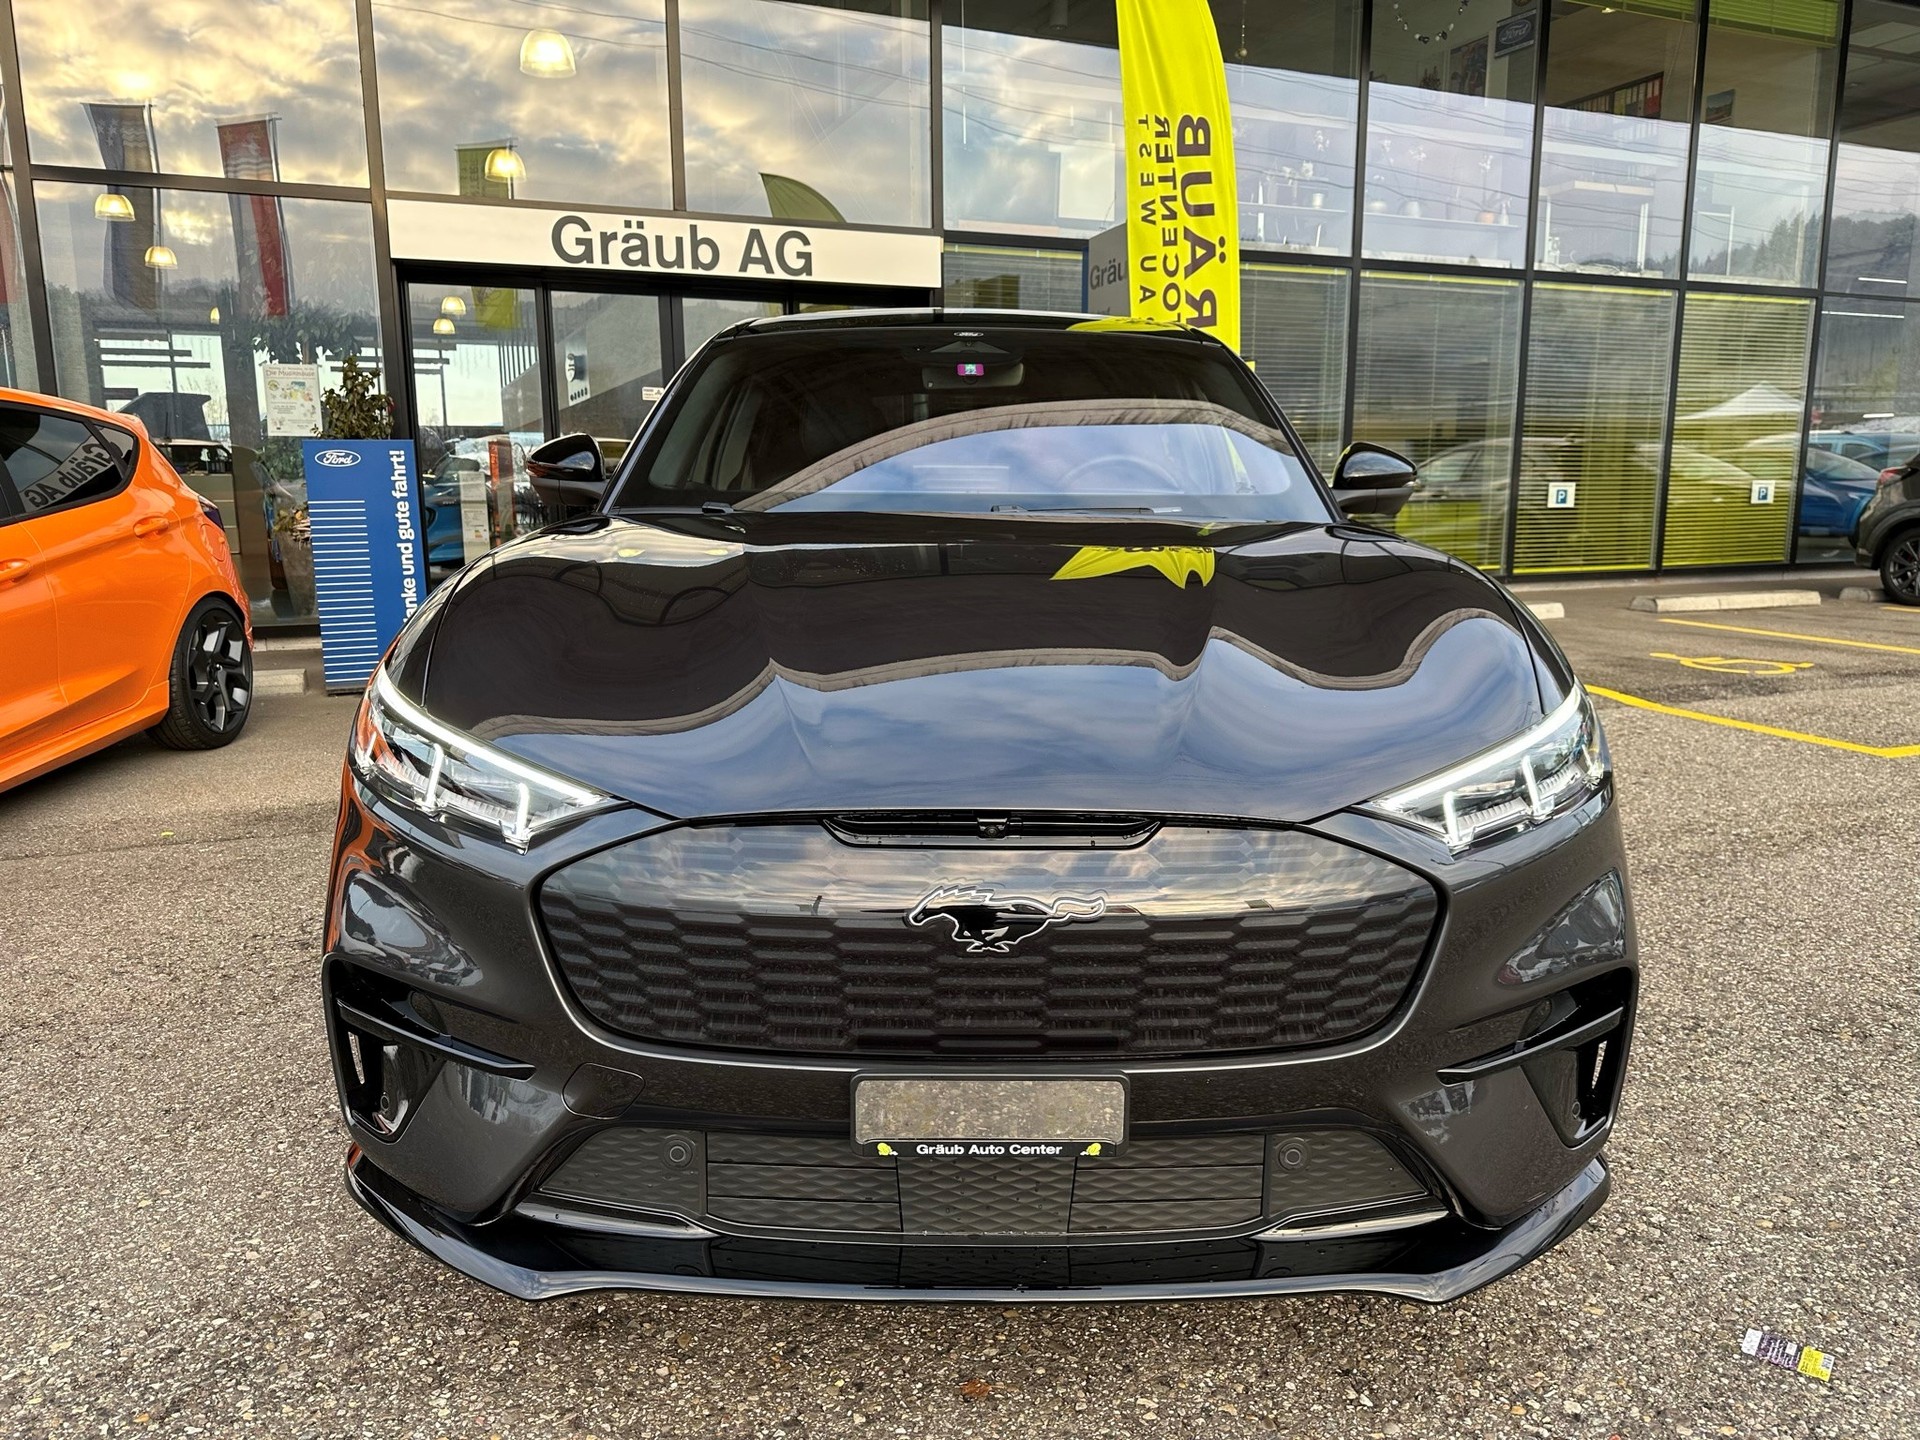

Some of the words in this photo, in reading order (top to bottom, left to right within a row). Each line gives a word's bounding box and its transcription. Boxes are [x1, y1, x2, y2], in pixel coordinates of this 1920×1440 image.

[551, 215, 720, 271] Gräub
[738, 228, 813, 277] AG
[1090, 258, 1128, 290] Gräu
[321, 450, 354, 466] Ford
[389, 450, 408, 499] fahrt!
[395, 501, 415, 541] gute
[397, 543, 415, 576] und
[401, 577, 418, 623] anke
[916, 1144, 964, 1155] Gräub
[968, 1144, 1005, 1155] Auto
[1009, 1144, 1063, 1155] Center
